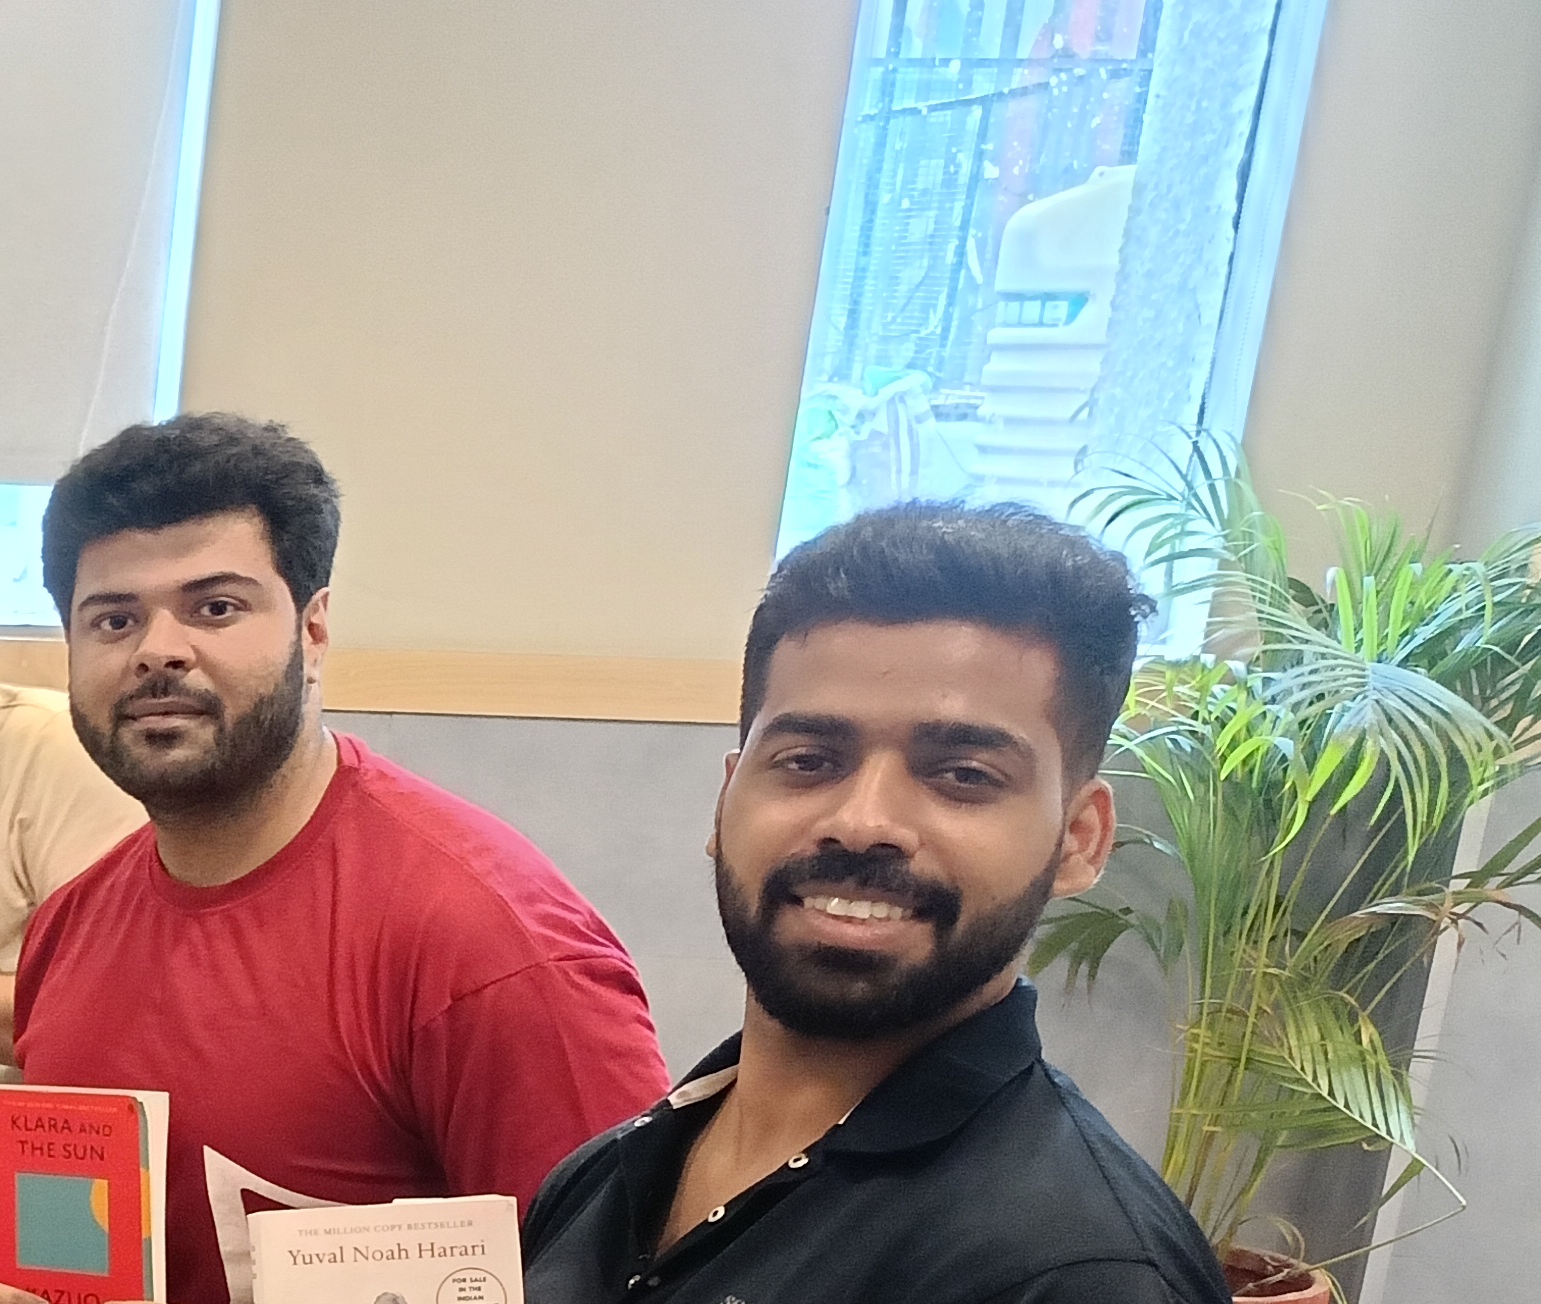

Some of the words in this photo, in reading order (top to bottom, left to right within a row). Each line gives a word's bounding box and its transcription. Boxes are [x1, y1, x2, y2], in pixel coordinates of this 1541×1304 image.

[11, 1114, 72, 1134] KLARA
[79, 1122, 112, 1137] AND
[17, 1140, 55, 1158] THE
[62, 1143, 105, 1161] SUN
[298, 1229, 319, 1237] THE
[324, 1226, 370, 1236] MILLION
[374, 1223, 402, 1233] COPY
[407, 1219, 474, 1231] BESTSELLER
[287, 1246, 345, 1266] Yuval
[353, 1242, 410, 1263] Noah
[417, 1239, 487, 1259] Harari
